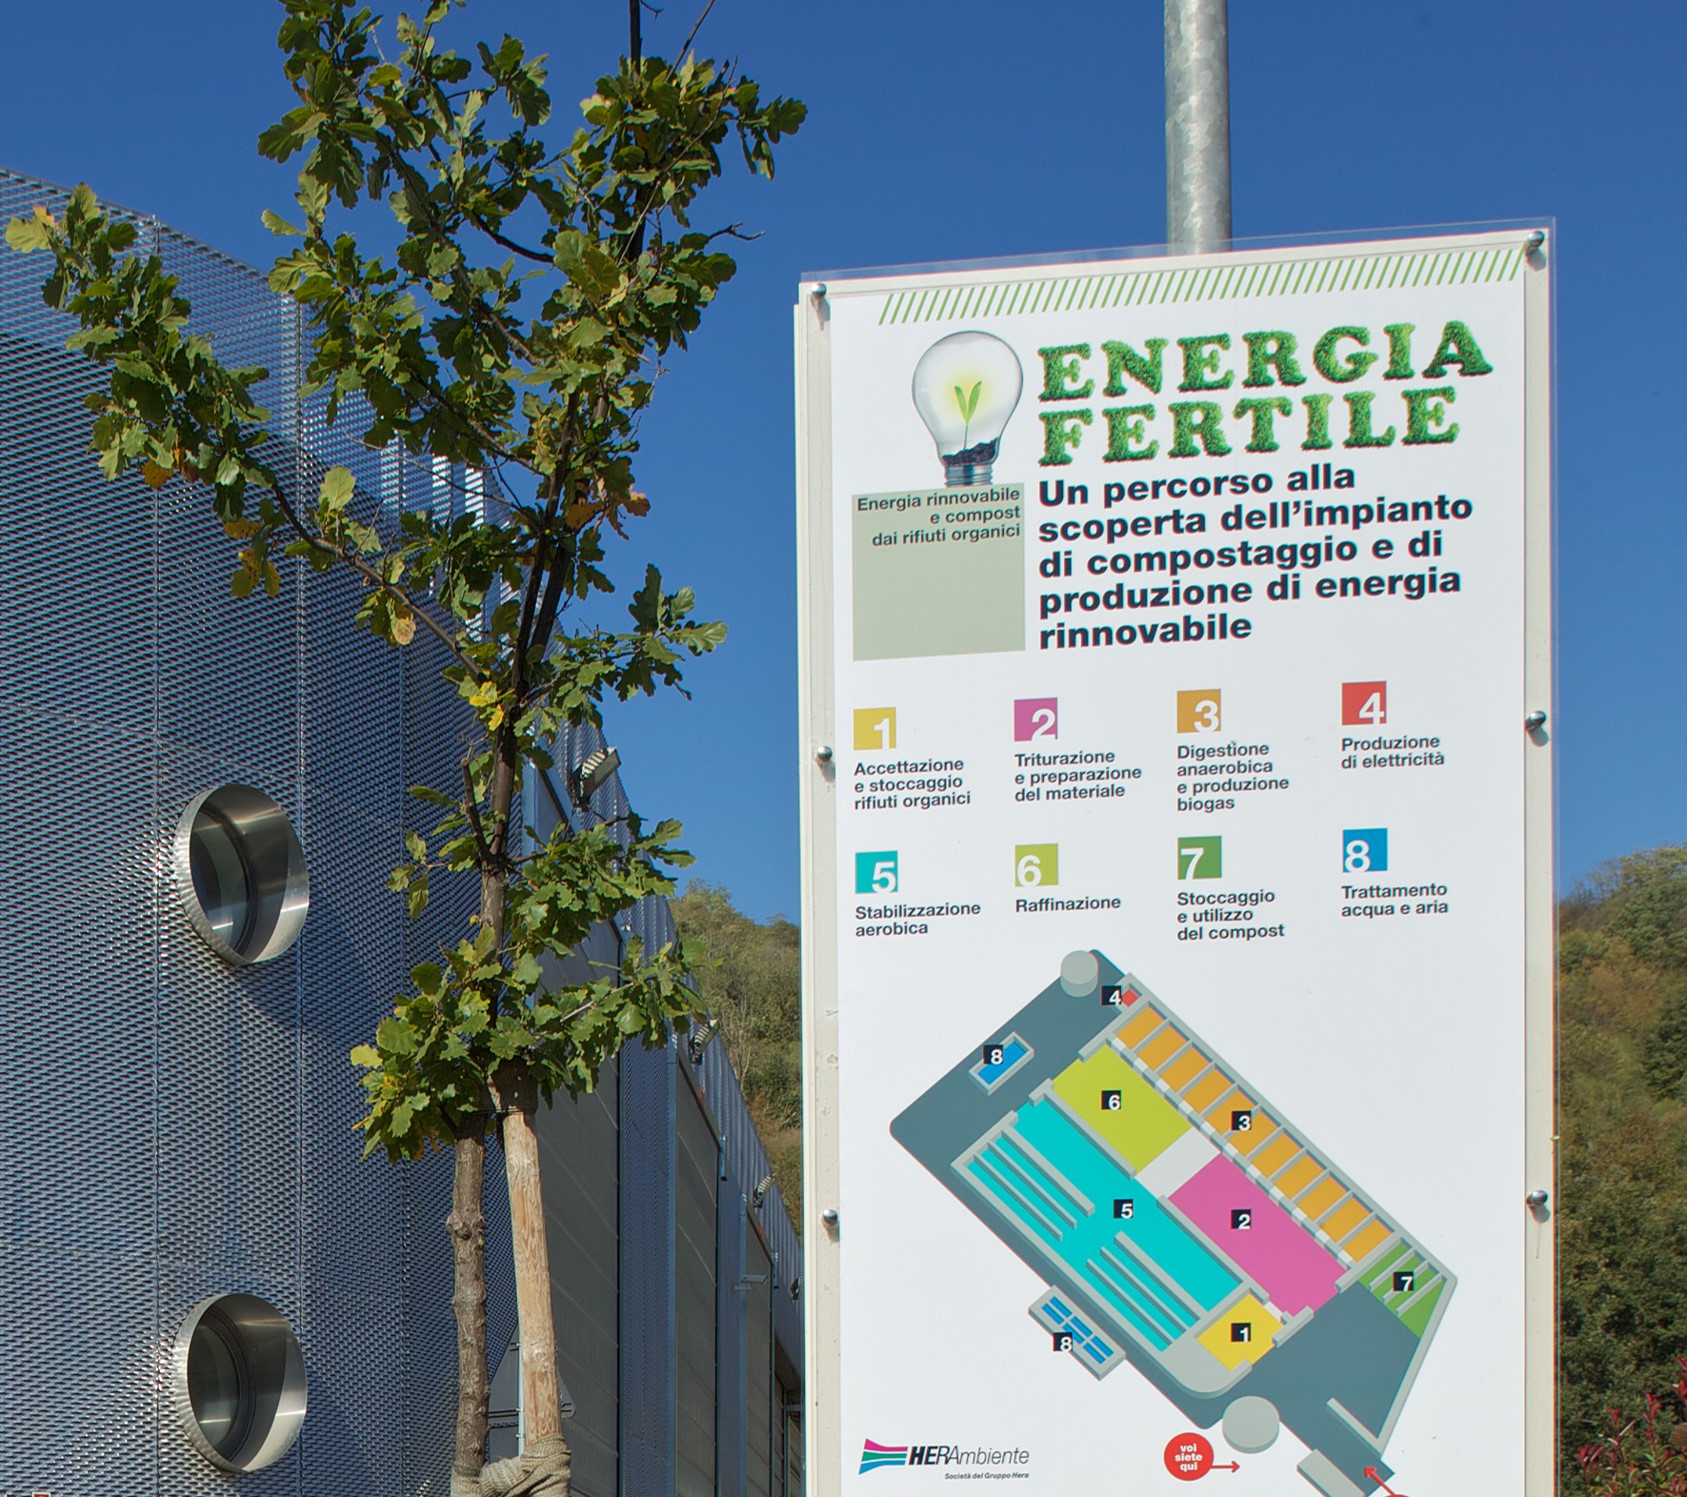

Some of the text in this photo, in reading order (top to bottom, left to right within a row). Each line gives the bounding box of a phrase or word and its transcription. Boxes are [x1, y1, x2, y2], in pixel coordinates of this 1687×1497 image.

[1037, 320, 1493, 402] ENERGIA
[1037, 386, 1459, 467] FERTILE
[1039, 464, 1355, 507] Un percorso alla
[857, 486, 1020, 512] Energia rinnovabile
[929, 505, 1021, 524] e compost
[872, 523, 1020, 546] dai rifiuti organici
[1038, 508, 1206, 545] scoperta
[1038, 530, 1443, 579] di compostaggio e di
[1038, 567, 1462, 619] produzione di energia
[1039, 613, 1253, 650] rinnovabile
[1193, 699, 1219, 732] 3
[1359, 692, 1385, 724] 4
[873, 717, 890, 749] 1
[1031, 708, 1056, 741] 2
[1177, 742, 1270, 761] Digestione
[1341, 734, 1440, 752] Produzione
[854, 757, 964, 776] Accettazione
[1014, 749, 1115, 768] Triturazione
[1341, 750, 1445, 769] di elettricità
[1014, 765, 1142, 786] e preparazione
[1177, 760, 1273, 777] anaerobica
[854, 774, 963, 793] e stoccaggio
[1015, 783, 1125, 802] del materiale
[1177, 777, 1290, 796] e produzione
[854, 790, 971, 810] rifiuti organici
[1177, 797, 1235, 814] biogas
[1180, 847, 1205, 880] 7
[1344, 840, 1370, 873] 8
[871, 862, 896, 892] 5
[1017, 855, 1042, 887] 6
[1177, 889, 1275, 906] Stoccaggio
[1341, 881, 1448, 900] Trattamento
[855, 902, 982, 920] Stabilizzazione
[1015, 895, 1122, 913] Raffinazione
[1341, 899, 1449, 919] acqua e aria
[1177, 906, 1254, 923] e utilizzo
[855, 922, 929, 937] aerobica
[1177, 923, 1285, 941] del compost
[1109, 990, 1121, 1005] 4
[991, 1049, 1003, 1065] 8
[1109, 1095, 1121, 1110] 6
[1238, 1115, 1251, 1131] 3
[1120, 1203, 1133, 1218] 5
[1237, 1213, 1251, 1230] 2
[1400, 1276, 1413, 1290] 7
[1059, 1336, 1072, 1352] 8
[1239, 1327, 1249, 1342] 1
[909, 1445, 1030, 1466] HERAmbiente
[1174, 1453, 1203, 1462] siete
[1180, 1443, 1197, 1453] voi
[945, 1472, 1030, 1480] Società del Gruppo Hera
[1179, 1461, 1198, 1472] qui
